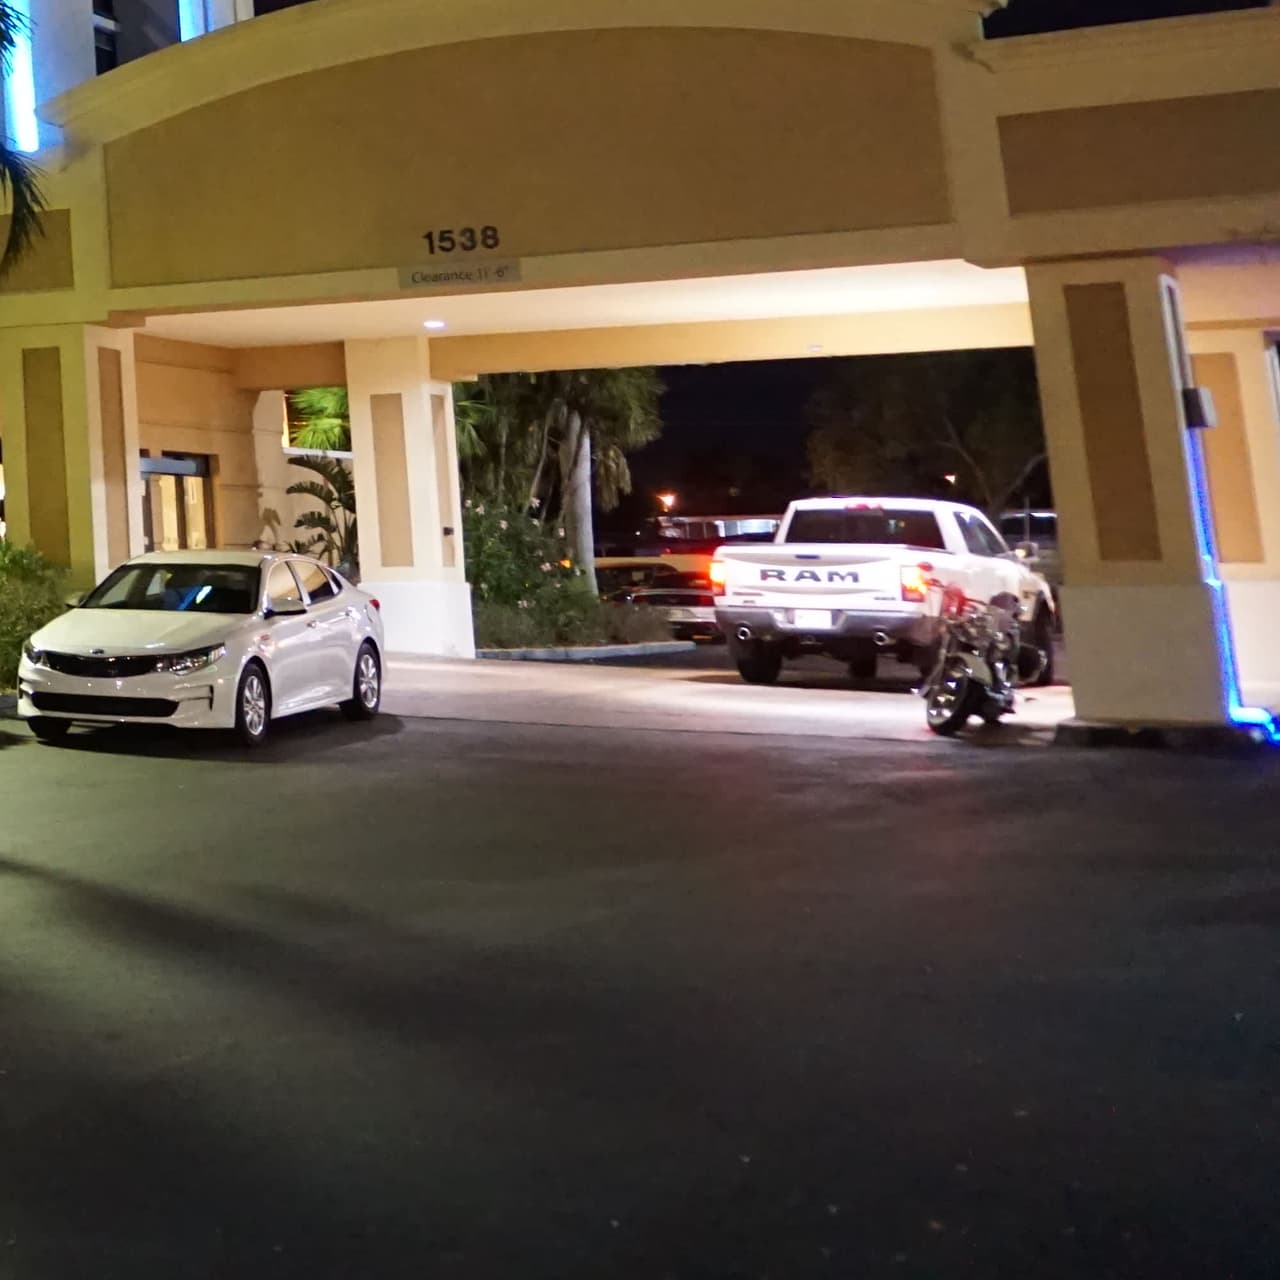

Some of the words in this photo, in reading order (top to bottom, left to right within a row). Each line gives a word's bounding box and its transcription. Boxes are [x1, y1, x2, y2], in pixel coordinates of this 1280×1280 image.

[422, 226, 500, 255] 1538
[411, 270, 473, 284] Clearance
[760, 569, 860, 583] RAM
